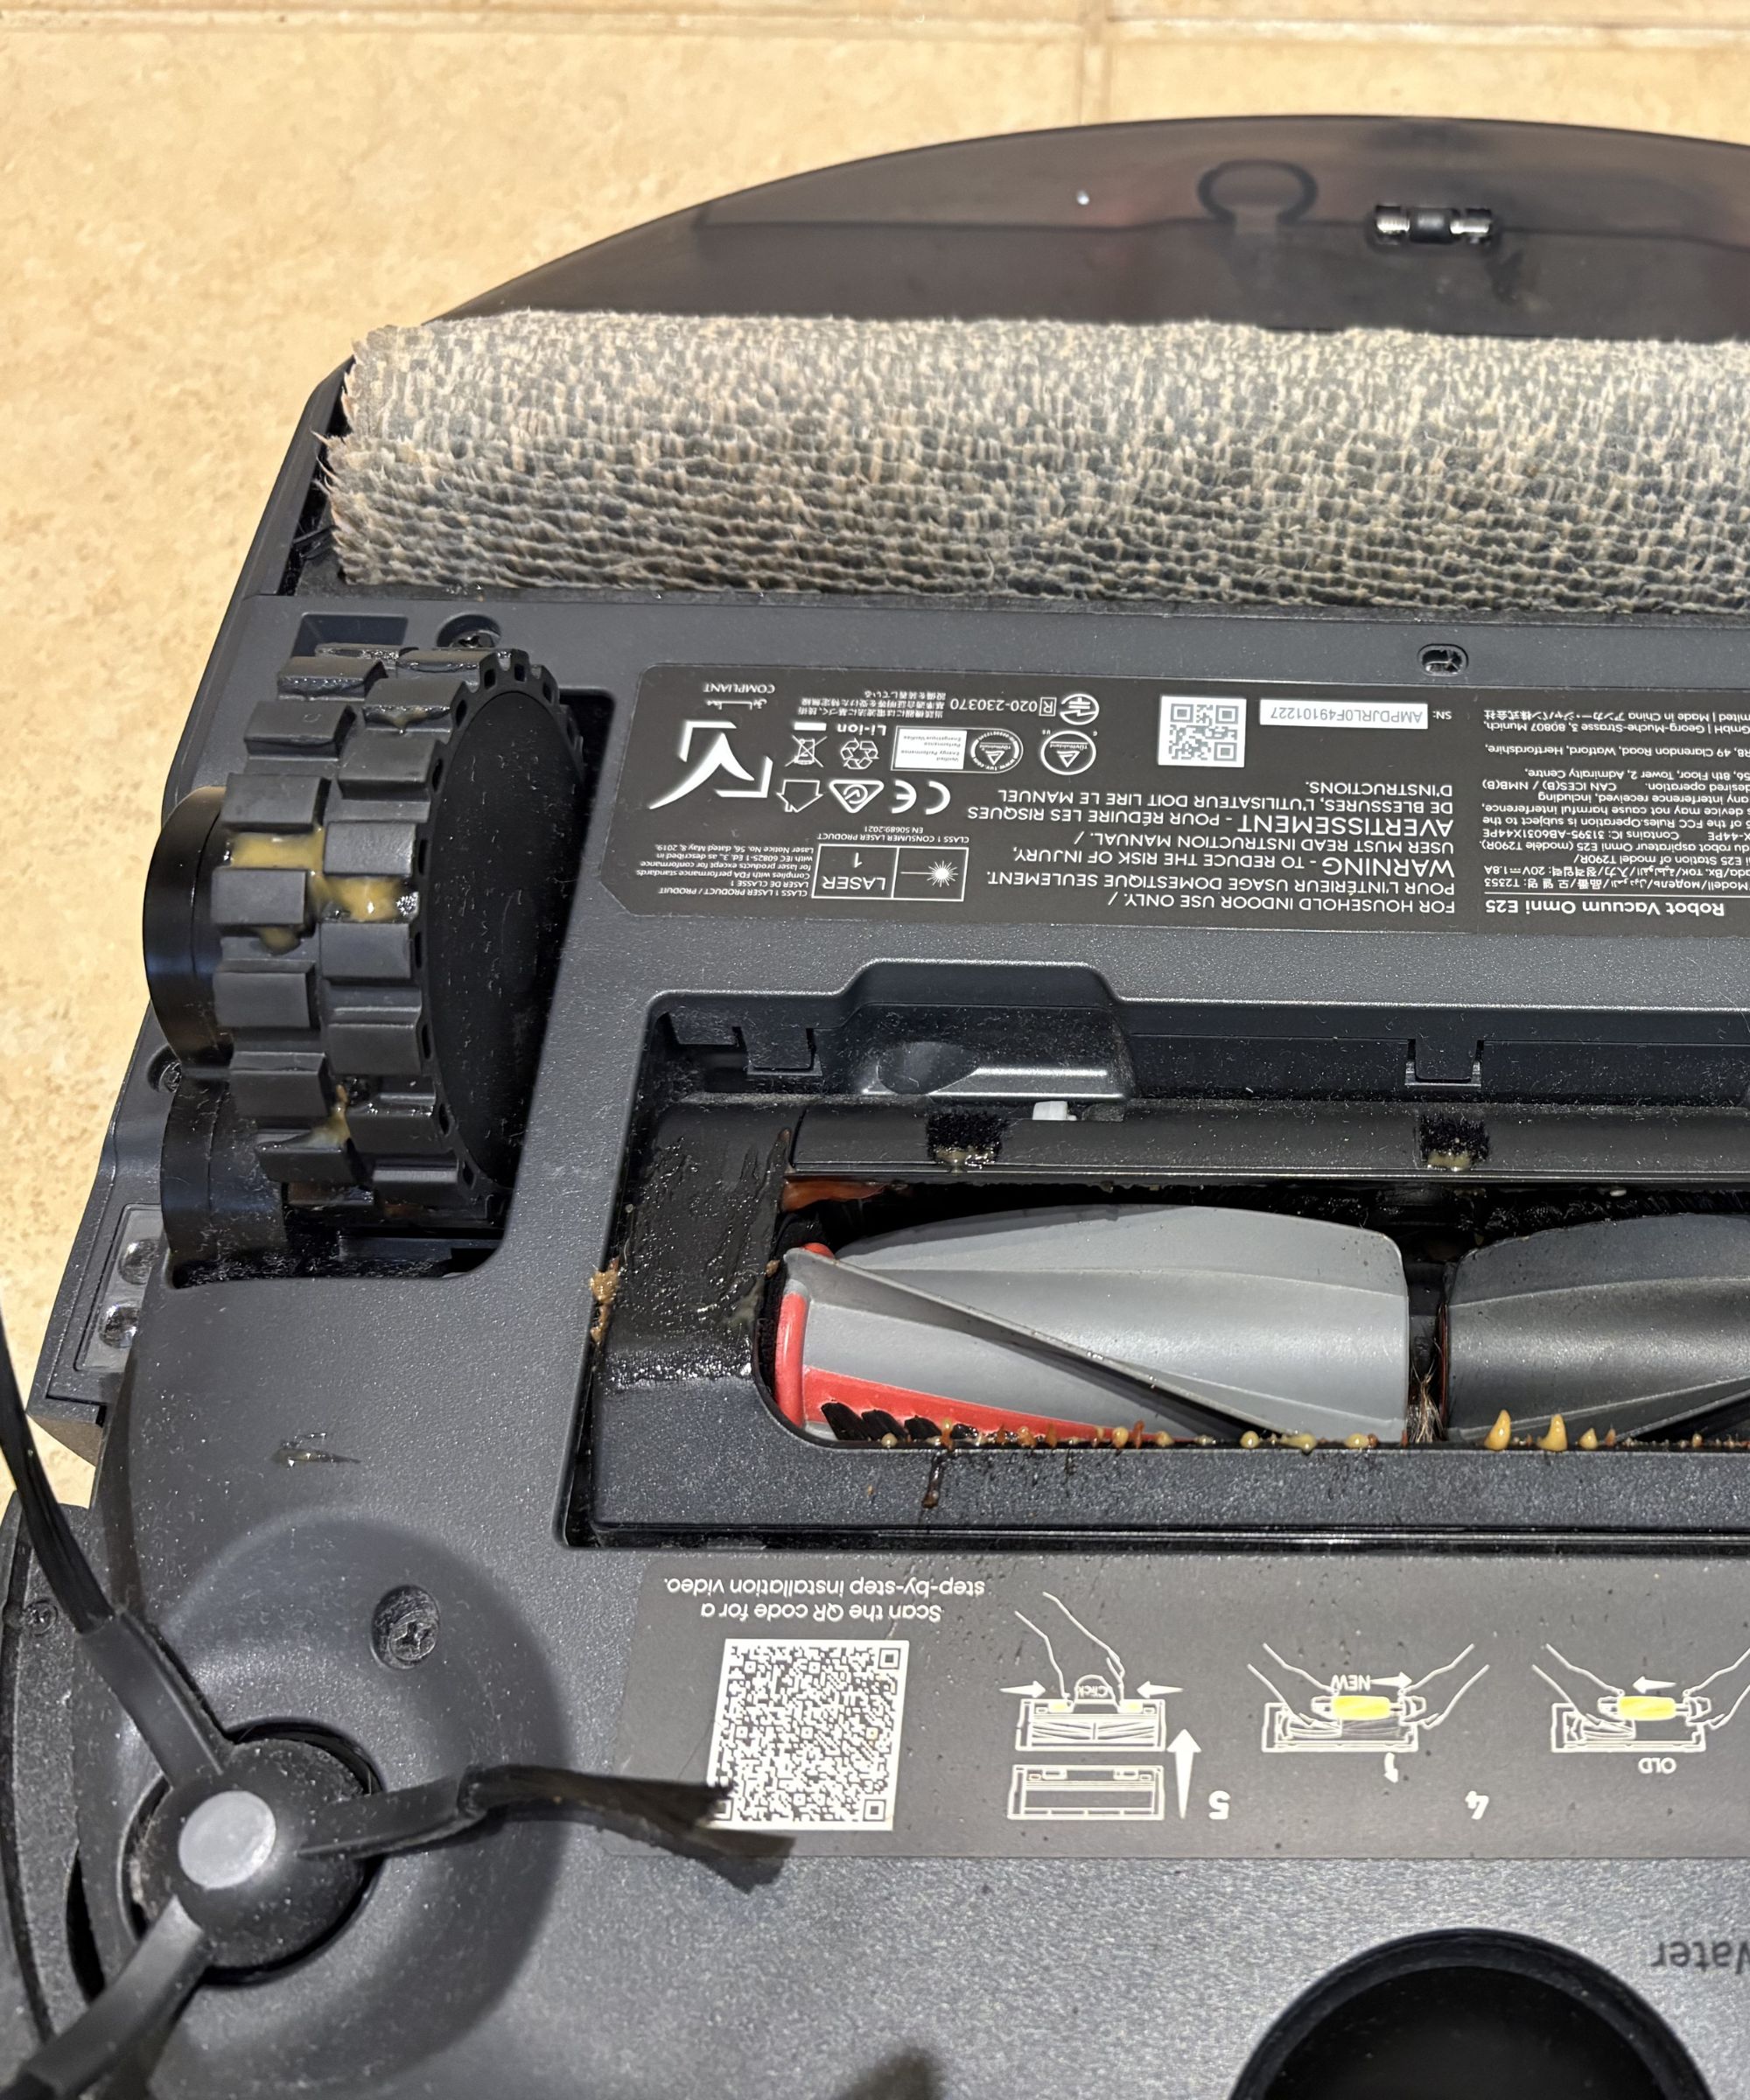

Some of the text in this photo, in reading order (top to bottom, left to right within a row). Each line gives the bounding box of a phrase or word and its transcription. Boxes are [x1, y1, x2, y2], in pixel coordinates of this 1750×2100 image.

[703, 682, 775, 694] COMPLIANT
[949, 697, 1038, 712] 020-230370
[1270, 706, 1423, 724] AMPDJRL0F49101227
[1432, 710, 1452, 720] SN:
[1628, 712, 1662, 722] China
[1663, 712, 1675, 723] in
[1676, 712, 1710, 723] Made
[836, 723, 887, 736] Li-ion
[1483, 719, 1750, 734] GmbH Georg-Muche-Strasse 3, 80807 Munich,
[1485, 744, 1732, 758] 49 Clarendon Road, Watford, Hertfordshire,
[1524, 768, 1566, 780] Centre,
[1568, 767, 1625, 780] Admiralty
[1627, 769, 1638, 780] 2,
[1640, 771, 1675, 780] Tower
[1676, 769, 1709, 780] Floor,
[1711, 772, 1731, 780] 8th
[1305, 781, 1452, 797] D'INSTRUCTIONS.
[1481, 779, 1529, 790] NMB(B)
[1542, 780, 1587, 792] ICES(B)
[1590, 781, 1617, 792] CAN
[1645, 780, 1706, 793] operation.
[998, 789, 1453, 815] DE BLESSURES, L'UTILISATEUR DOIT LIRE LE MANUEL
[1537, 791, 1749, 804] any interference received, including
[1481, 802, 1744, 817] device may not cause harmful interference,
[967, 806, 1454, 837] AVERTISSEMENT POUR RÉDUIRE LES RISQUES
[1482, 816, 1502, 826] the
[1504, 816, 1518, 826] to
[1521, 815, 1564, 827] subject
[1567, 817, 1578, 828] is
[1678, 818, 1704, 829] FCC
[1706, 819, 1727, 830] the
[1729, 819, 1742, 830] of
[864, 825, 911, 834] 50689:2021
[1482, 828, 1680, 841] Contains IC: 31395-AB6031X44PE
[816, 832, 858, 841] PRODUCT
[886, 834, 935, 843] CONSUMER
[1089, 832, 1454, 855] USER MUST READ INSTRUCTION MANUAL.
[1479, 838, 1749, 853] du robot aspirateur Omni E25 (modèle T290R).
[853, 852, 863, 868] 1
[1012, 846, 1455, 878] WARNING TO REDUCE THE RISK OF INJURY,
[1573, 853, 1742, 866] E25 Station of model T290R/
[822, 876, 886, 891] LASER
[986, 871, 1455, 896] POUR L'INTÉRIEUR USAGE DOMESTIQUE SEULEMENT.
[1483, 878, 1521, 888] T2353
[1124, 893, 1455, 914] FOR HOUSEHOLD INDOOR USE ONLY.
[1485, 899, 1725, 917] Robot Vacuum Omni E25
[663, 1577, 985, 1598] step-by-step installation video.
[700, 1602, 944, 1623] Scan the QR code for a
[1074, 1682, 1110, 1698] Click
[1328, 1674, 1373, 1693] NEW
[1637, 1757, 1677, 1774] OLD
[1208, 1790, 1231, 1820] 5
[1465, 1790, 1489, 1820] 4
